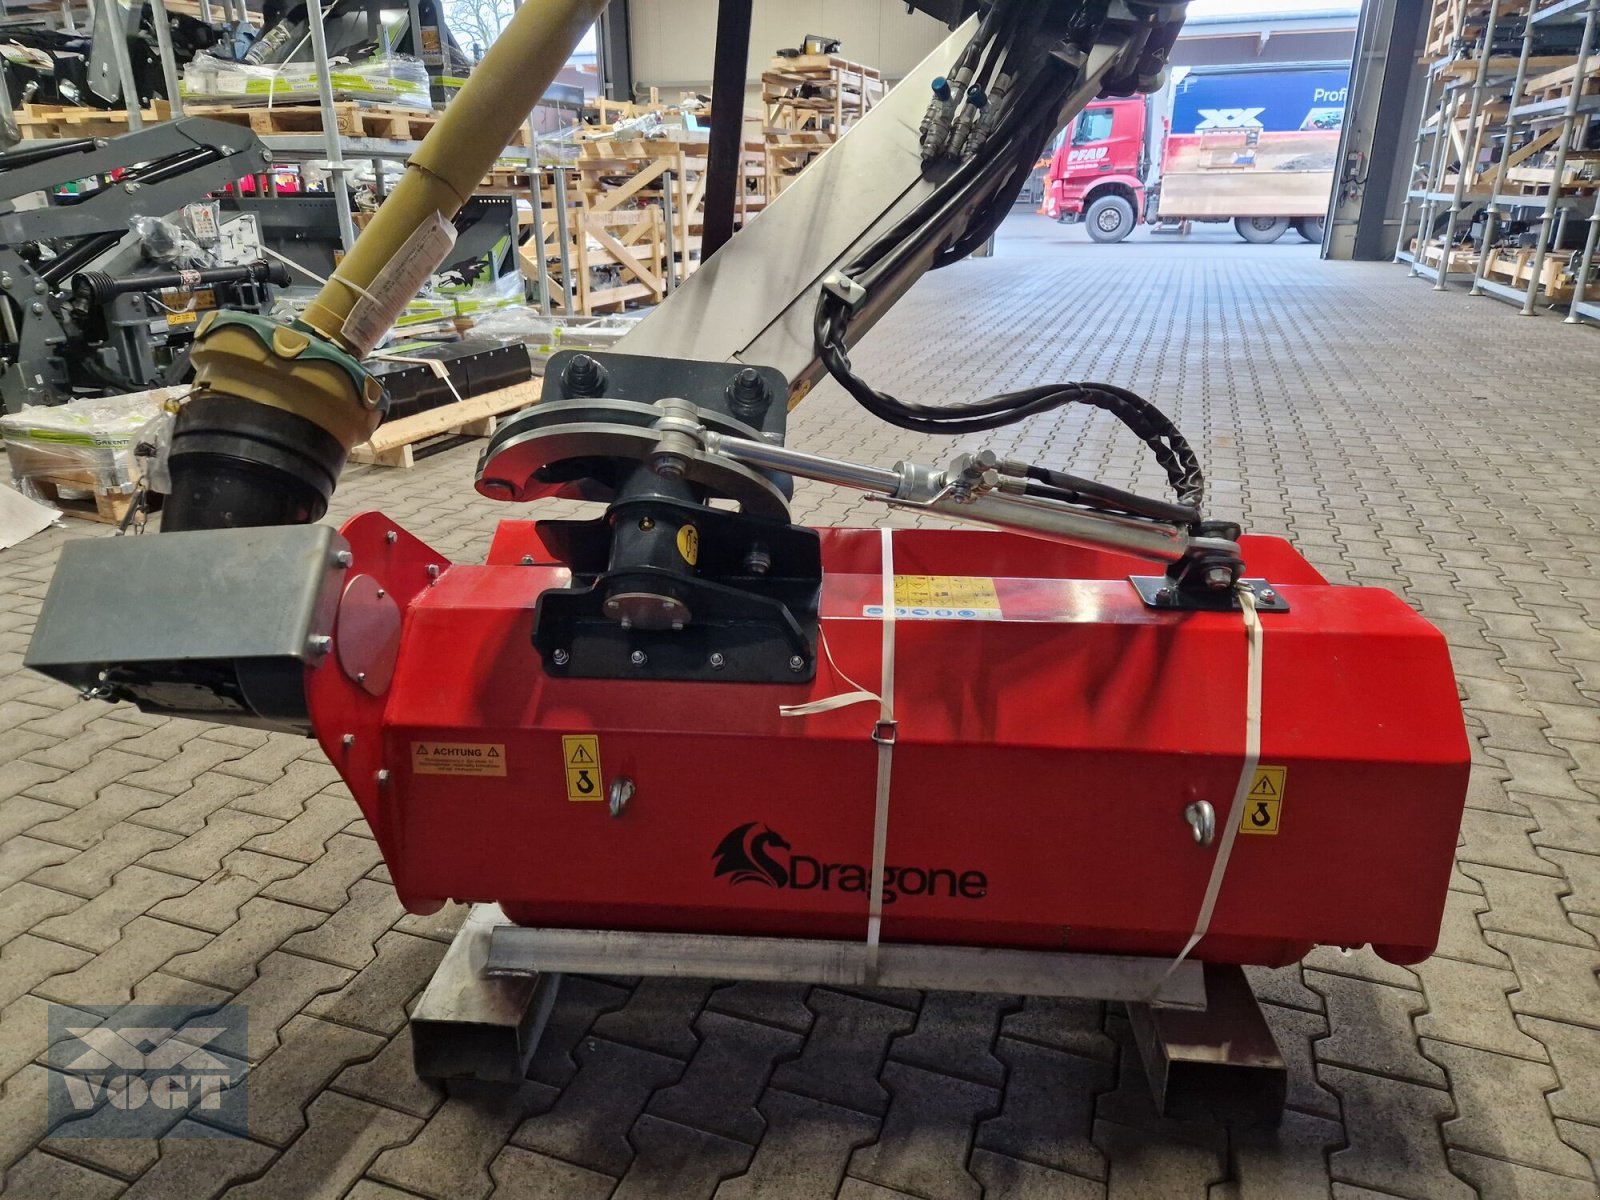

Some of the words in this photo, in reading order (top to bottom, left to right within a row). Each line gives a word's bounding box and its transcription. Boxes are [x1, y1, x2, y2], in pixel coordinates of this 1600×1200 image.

[1067, 147, 1109, 162] PFAU
[433, 747, 482, 757] ACHTUNG
[789, 854, 988, 905] Dragone
